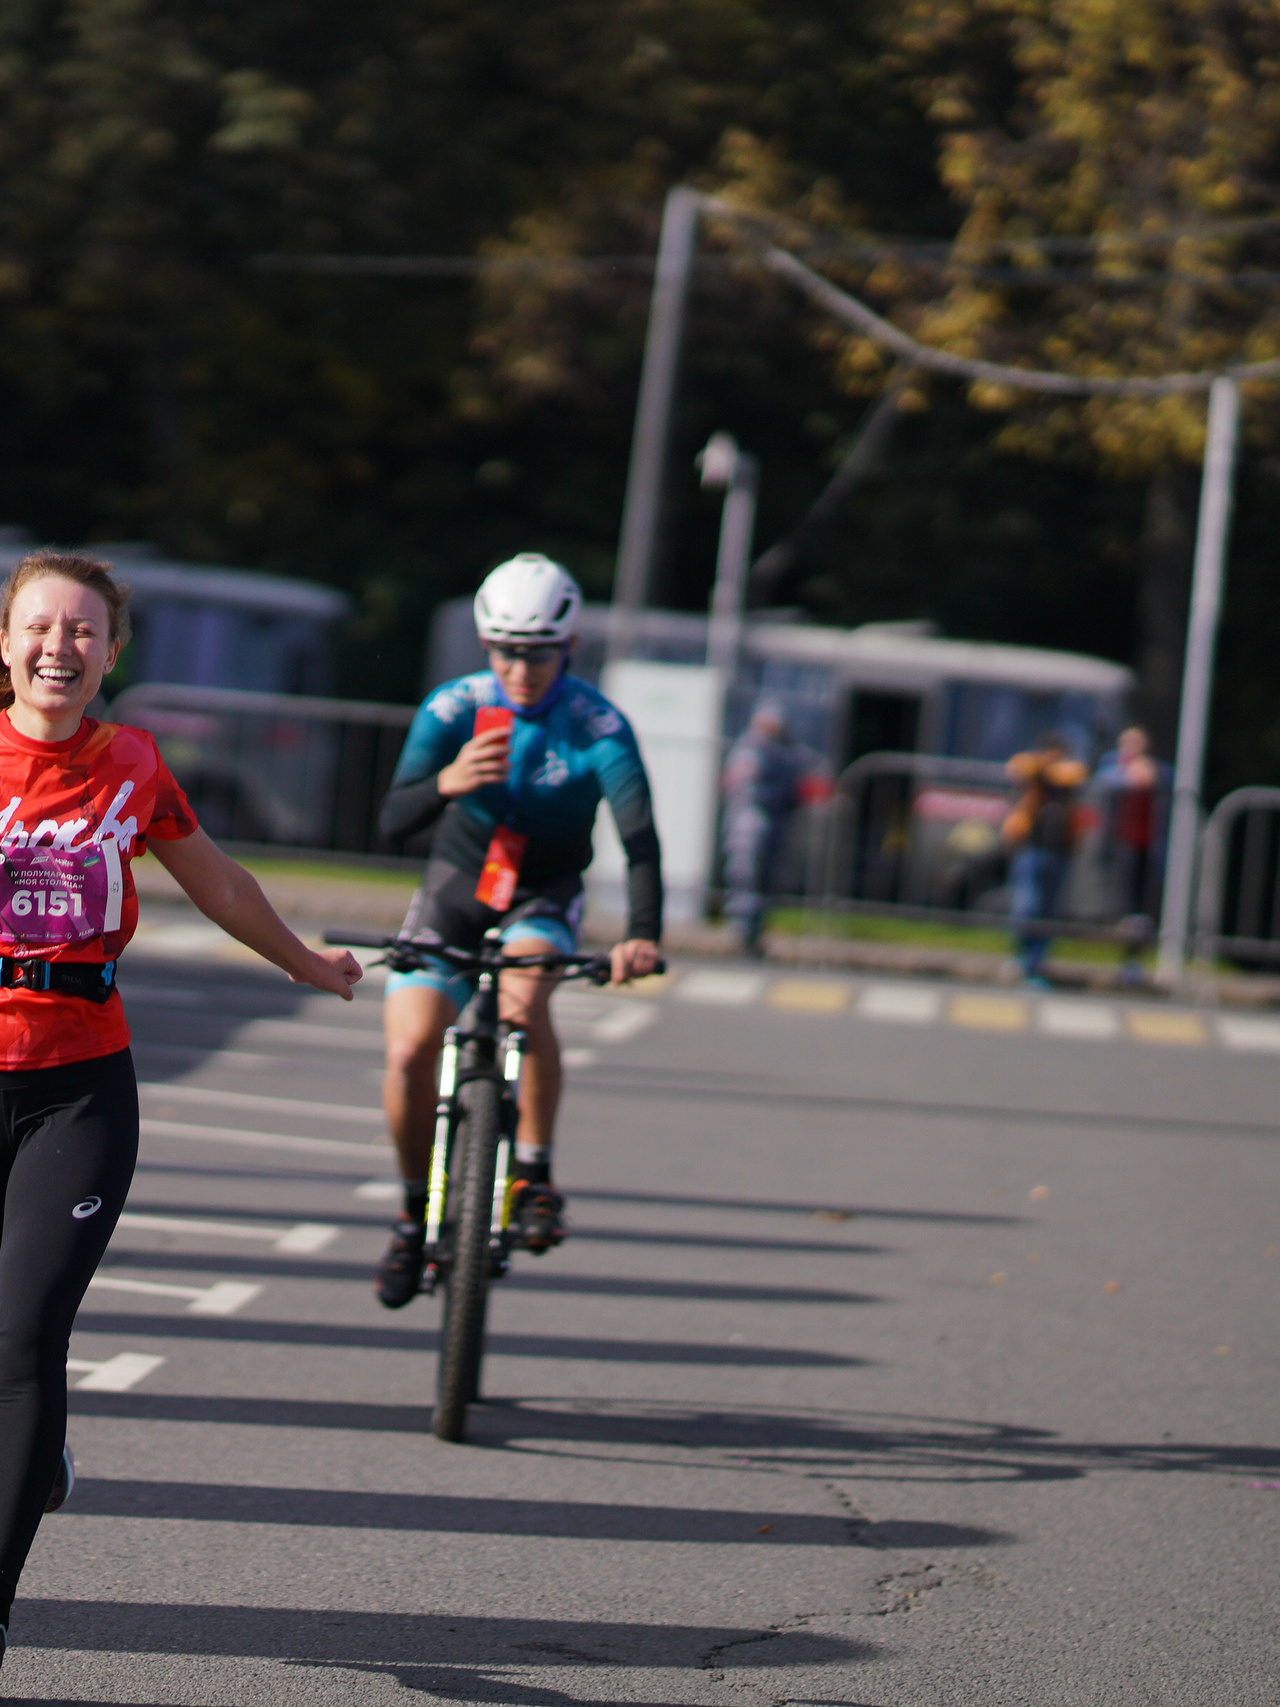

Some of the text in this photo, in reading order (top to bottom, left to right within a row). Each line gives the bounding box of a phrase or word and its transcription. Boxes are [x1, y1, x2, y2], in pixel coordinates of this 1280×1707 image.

[10, 870, 85, 881] IV ПОЛУМАРАФОН
[14, 878, 83, 889] «МОЯ СТОЛИЦА»
[11, 889, 82, 917] 6151
